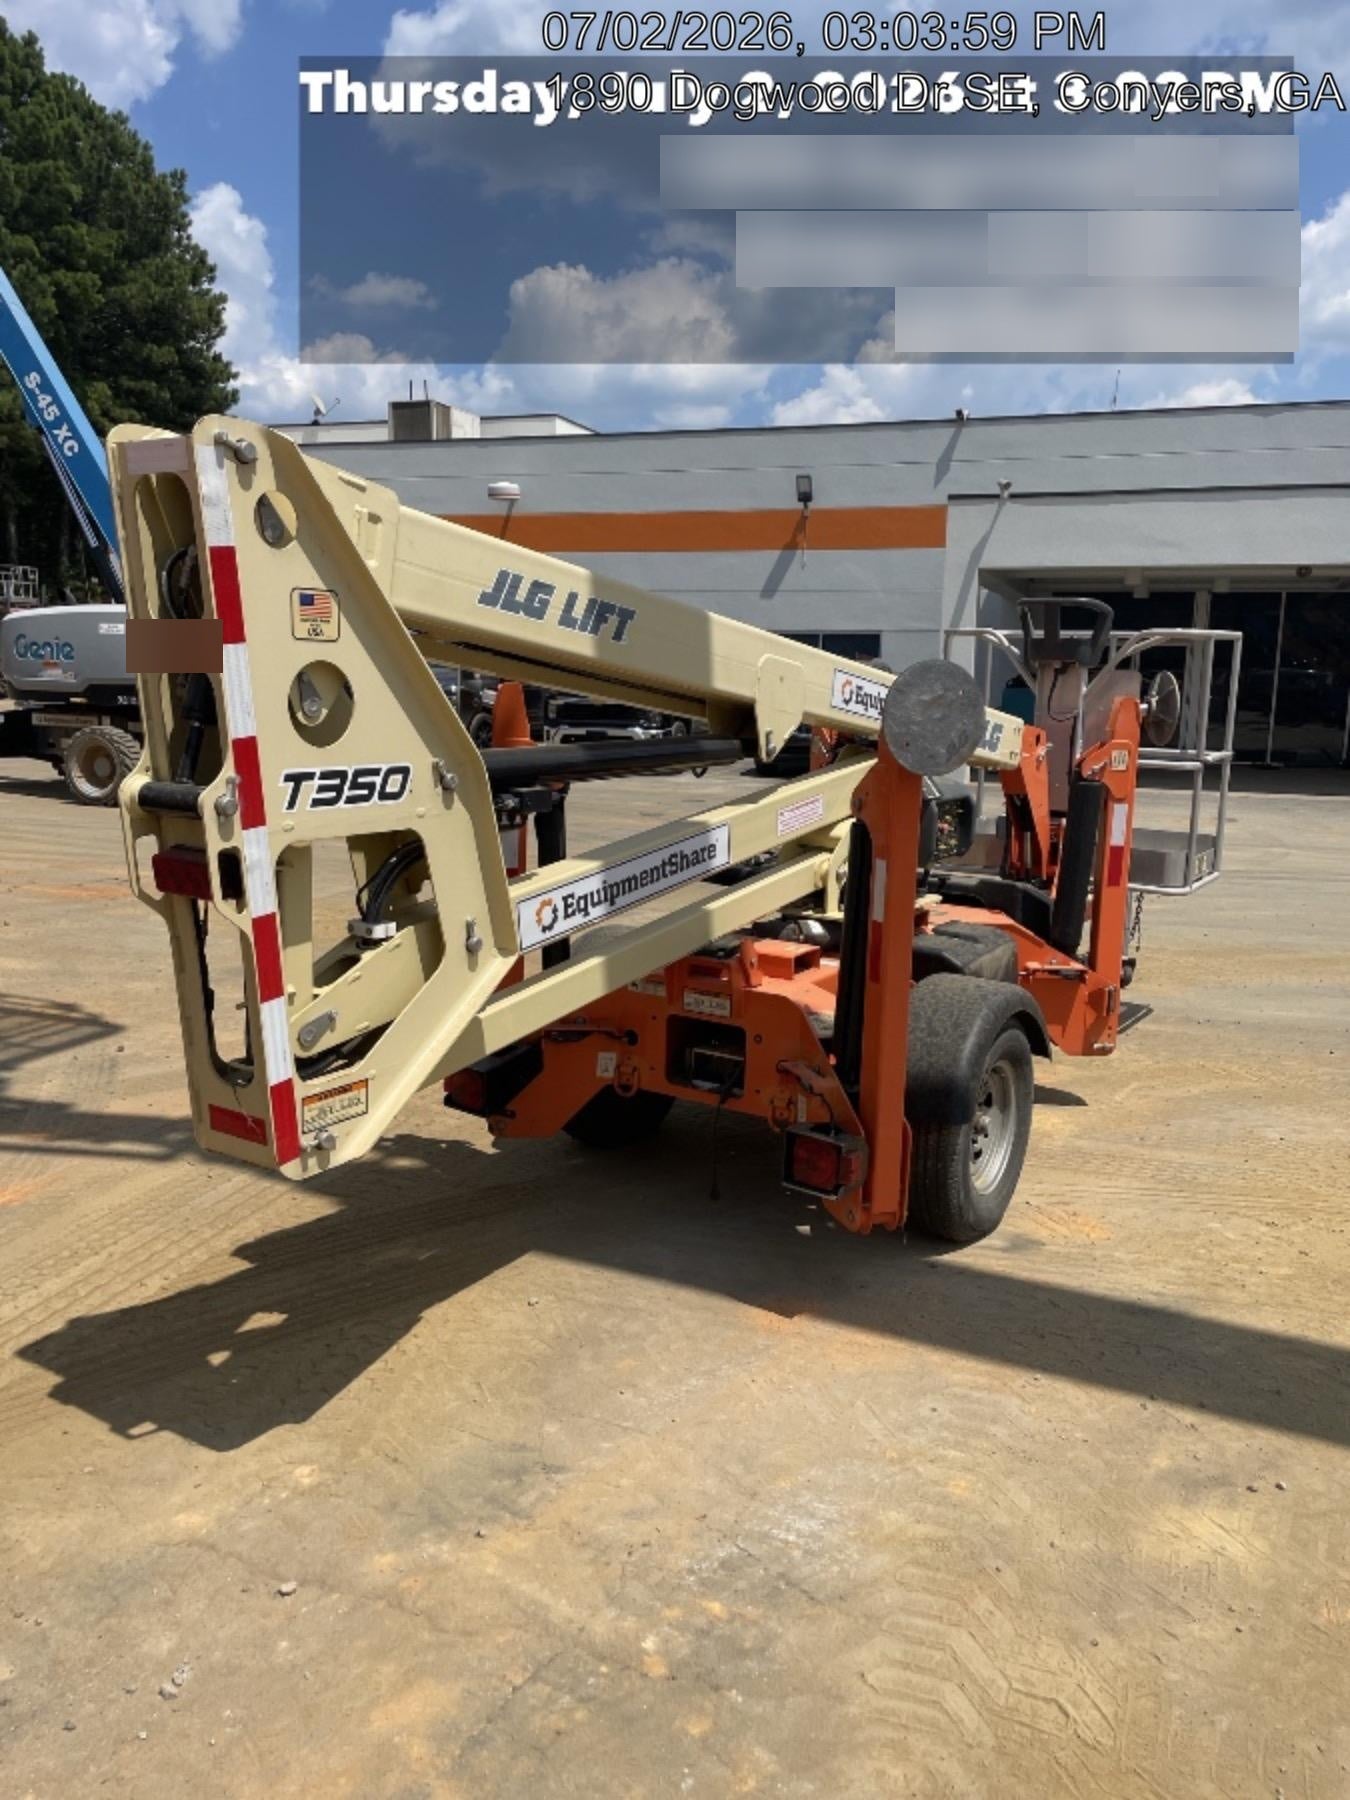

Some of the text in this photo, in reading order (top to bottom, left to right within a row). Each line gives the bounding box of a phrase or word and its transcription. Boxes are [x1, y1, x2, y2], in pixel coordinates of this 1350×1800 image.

[24, 371, 79, 457] S-45 XC
[477, 568, 638, 643] JLG LIFT
[13, 633, 75, 662] Genie
[279, 762, 413, 812] T350
[561, 842, 718, 920] EquipmentShare
